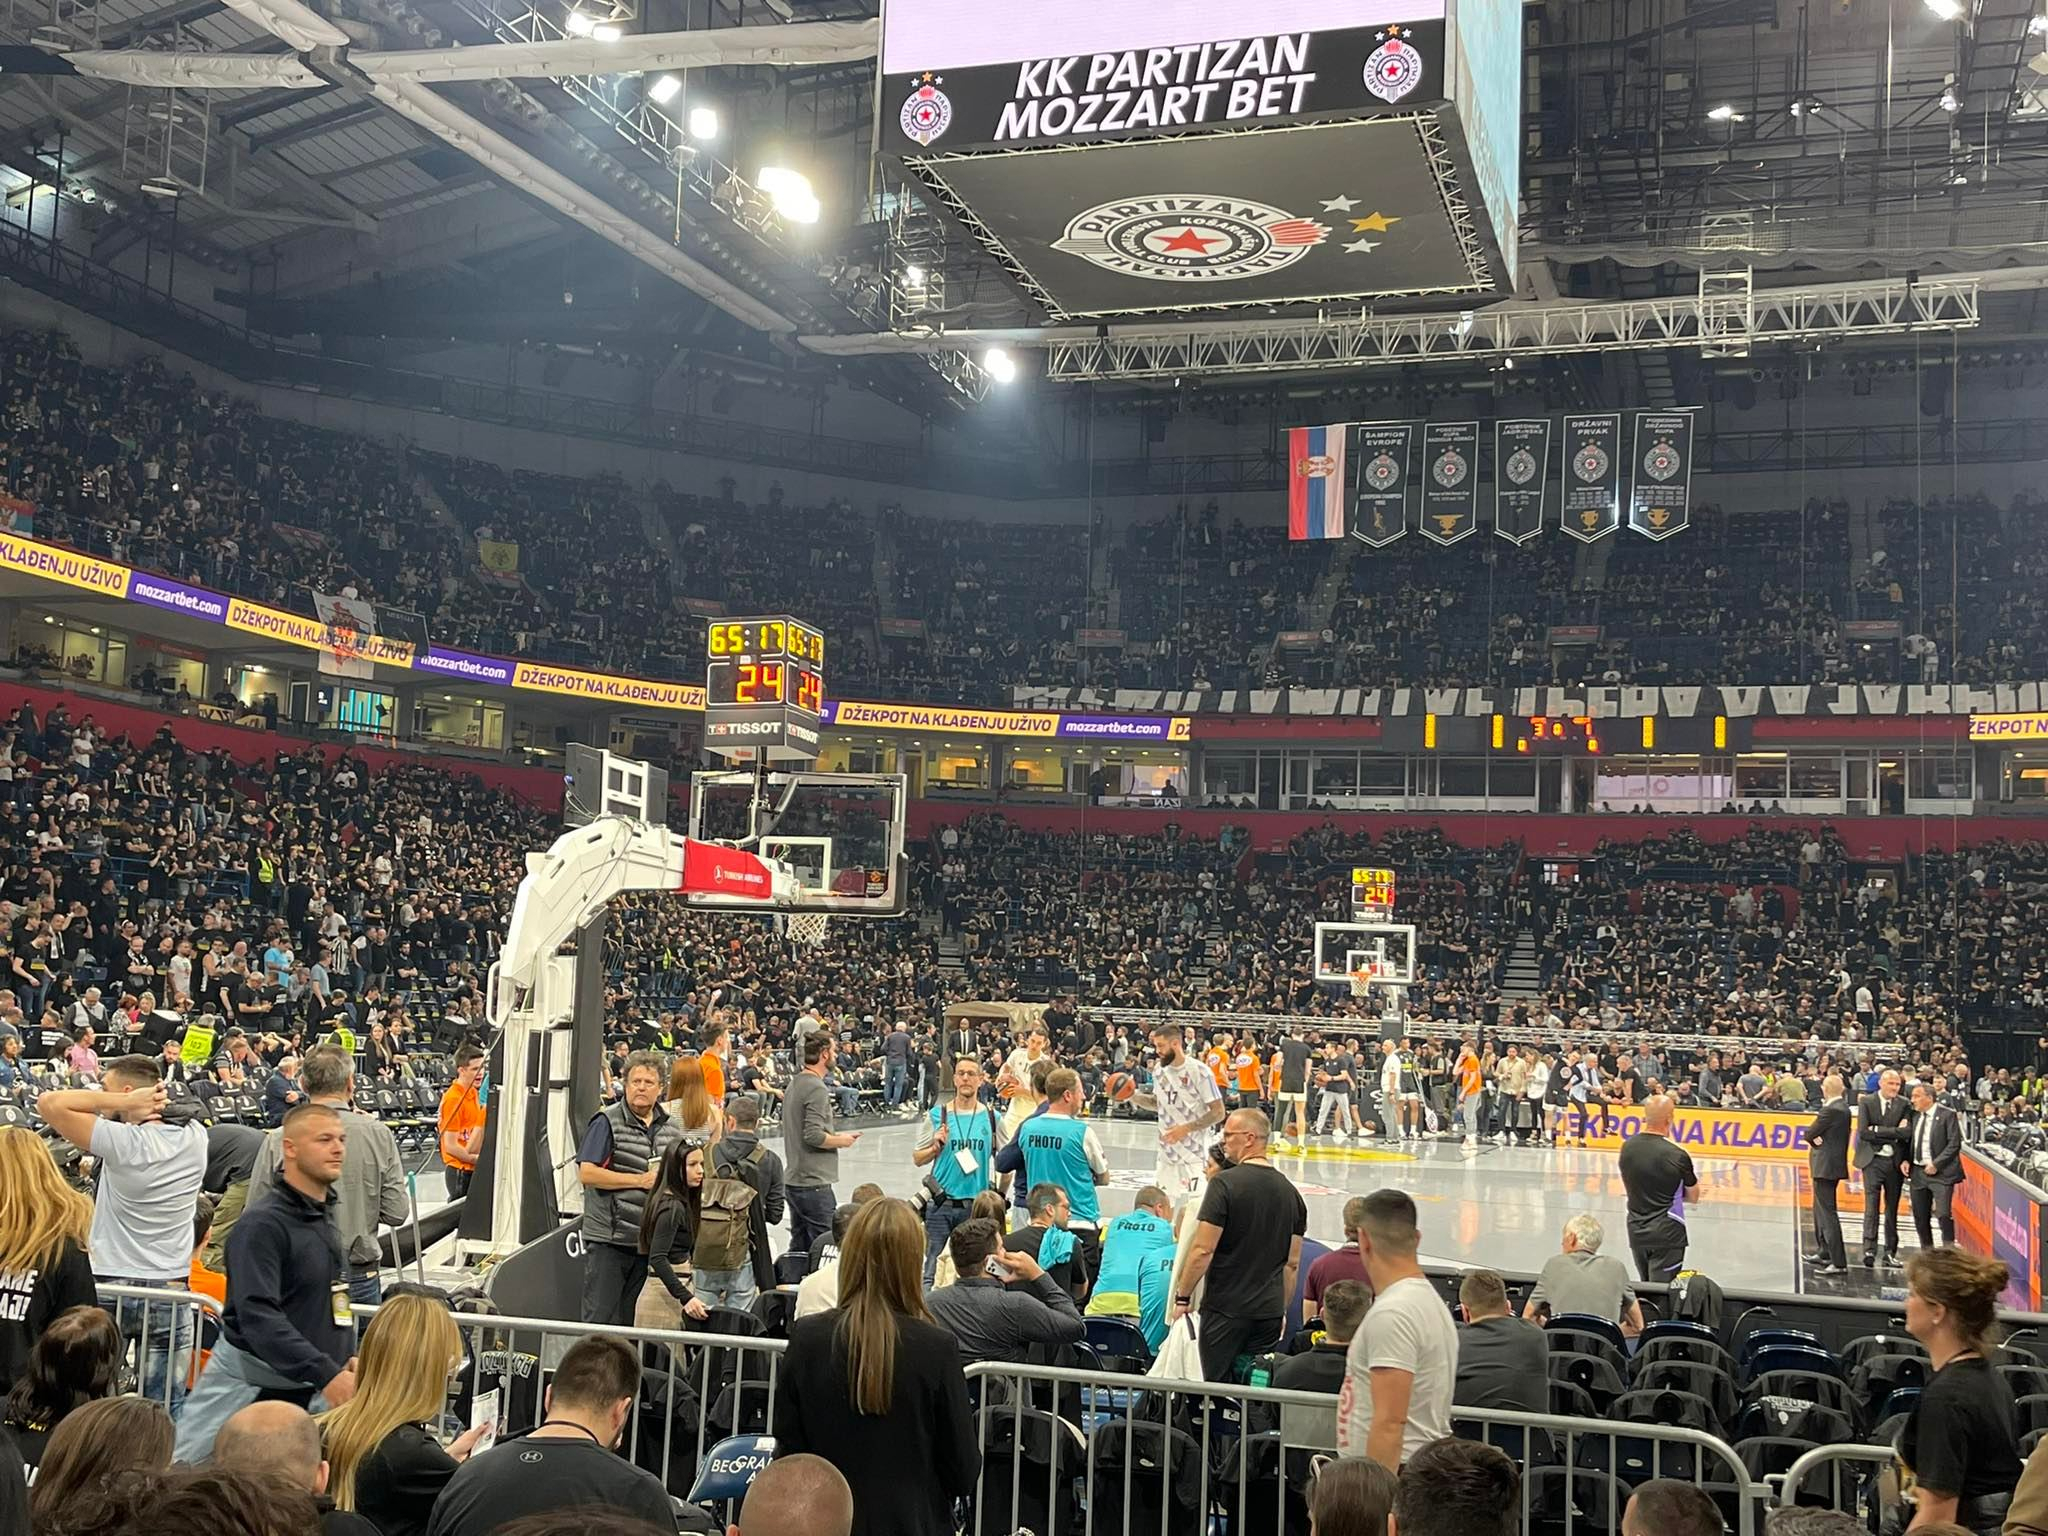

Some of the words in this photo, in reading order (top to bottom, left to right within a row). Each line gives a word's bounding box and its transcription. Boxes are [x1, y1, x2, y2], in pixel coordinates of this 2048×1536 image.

[1015, 57, 1079, 98] KK
[1085, 33, 1310, 92] PARTIZAN
[993, 82, 1219, 140] MOZZART
[1225, 73, 1316, 119] BET
[1077, 199, 1269, 233] PARTIZAN
[1571, 420, 1612, 428] DRŽAVNI
[80, 562, 122, 590] UŽIVO
[135, 583, 222, 616] mozzartbet.com
[232, 605, 286, 634] DŽEKPOT
[288, 621, 302, 641] NA
[711, 623, 784, 653] 65:17
[420, 655, 507, 679] mozzartbet.com
[520, 667, 584, 691] DŽEKPOT
[585, 679, 603, 694] NA
[605, 681, 679, 704] KLAĐENJU
[680, 689, 706, 706] UŽI
[736, 665, 783, 702] 24
[799, 671, 821, 712] 24
[727, 722, 782, 735] TISSOT
[843, 705, 909, 724] DŽEKPOT
[910, 712, 929, 725] NA
[932, 714, 1006, 730] KLAĐENJU
[1009, 716, 1051, 732] UŽIVO
[1065, 722, 1162, 734] mozzartbet.com
[1365, 887, 1388, 903] 24
[1167, 1091, 1178, 1105] 17
[951, 1138, 985, 1151] PHOTO
[1028, 1134, 1062, 1150] PHOTO
[1670, 1119, 1704, 1145] NA
[1711, 1120, 1812, 1150] KLAĐE
[1117, 1221, 1155, 1232] PHOTO
[711, 1455, 773, 1473] BEOGRA
